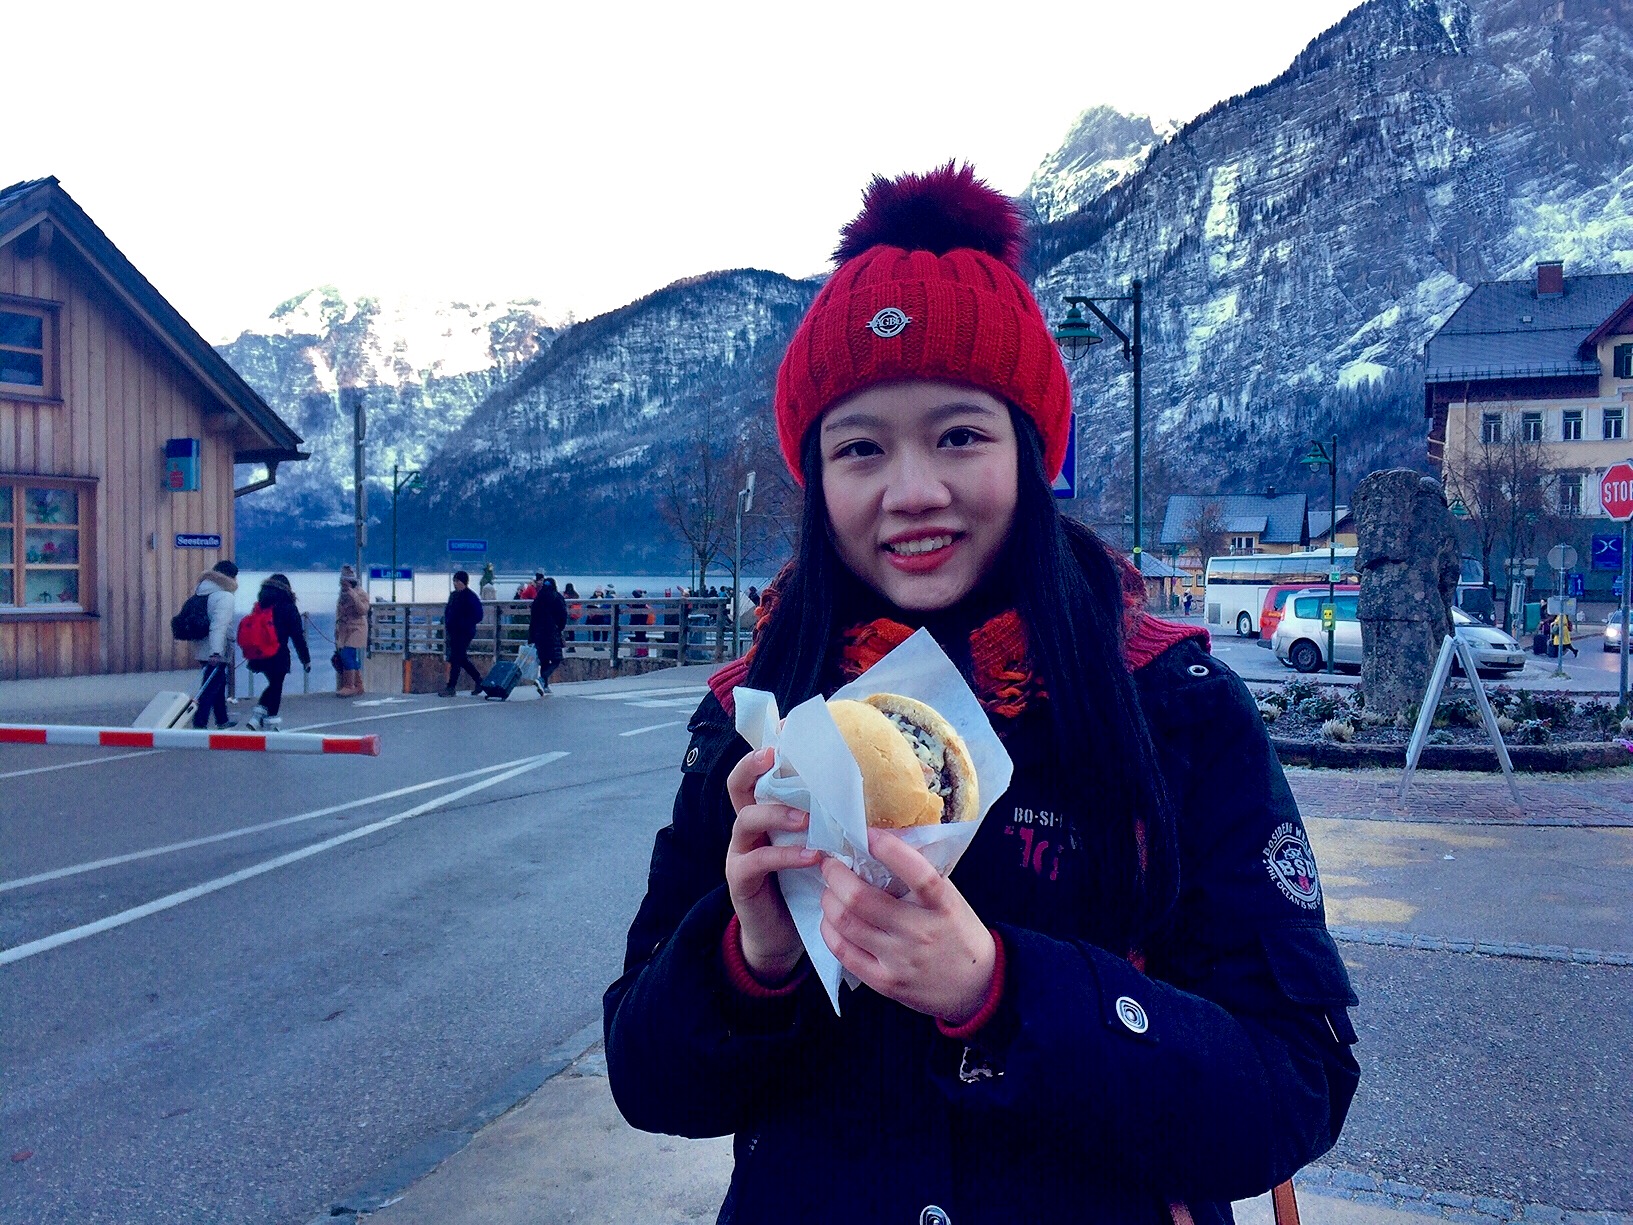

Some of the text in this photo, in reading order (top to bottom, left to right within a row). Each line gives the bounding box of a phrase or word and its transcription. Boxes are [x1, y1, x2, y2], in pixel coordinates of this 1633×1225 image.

[177, 535, 219, 546] Seestraße
[1266, 864, 1279, 882] THE
[1276, 881, 1300, 906] OCEAN
